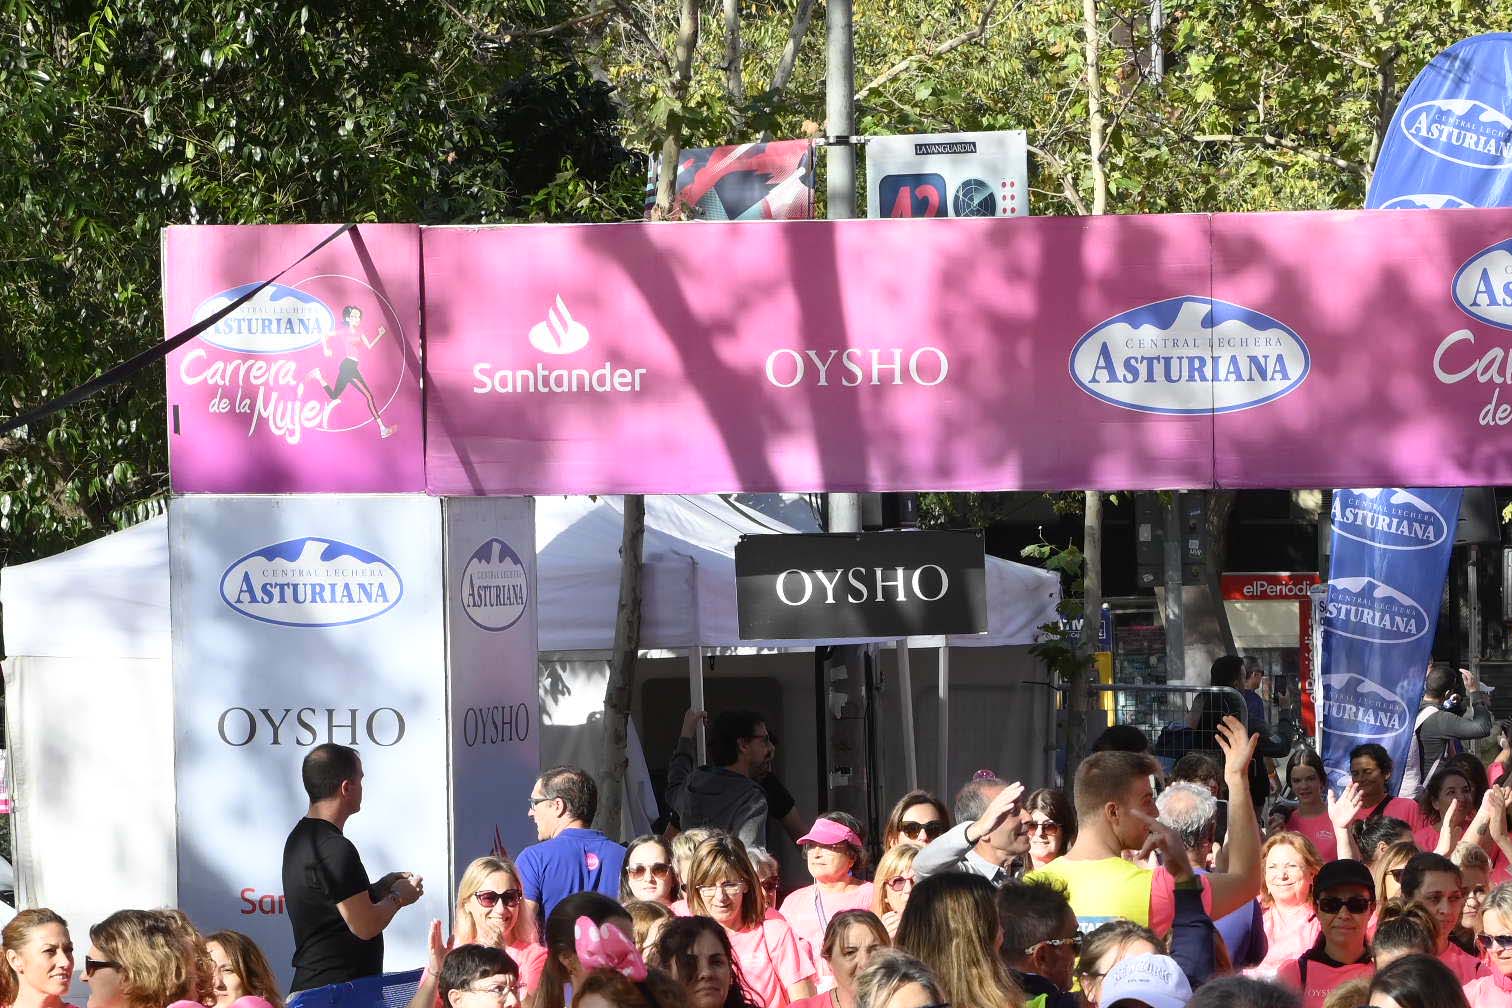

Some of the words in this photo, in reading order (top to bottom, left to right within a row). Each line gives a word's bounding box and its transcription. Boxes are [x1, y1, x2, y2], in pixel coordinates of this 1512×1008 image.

[212, 310, 323, 336] ASTURIANA
[1125, 338, 1201, 349] CENTRAL
[1208, 336, 1284, 347] LECHERA
[180, 348, 298, 387] Carrera
[472, 362, 647, 394] Santander
[765, 347, 949, 388] OYSHO
[1089, 342, 1292, 385] ASTURIANA
[208, 389, 230, 414] de
[235, 386, 251, 414] la
[248, 382, 342, 445] Mujer
[1330, 496, 1437, 542] ASTURIANA
[234, 571, 391, 606] ASTURIANA
[262, 569, 319, 578] CENTRAL
[325, 568, 385, 578] LECHERA
[466, 573, 525, 609] ASTURIANA
[776, 564, 949, 606] OYSHO
[1243, 580, 1312, 597] elPeriódi
[1326, 602, 1418, 635] STURIANA
[218, 706, 406, 747] OYSHO
[463, 702, 530, 748] OYSHO
[1324, 700, 1400, 730] TURIANA
